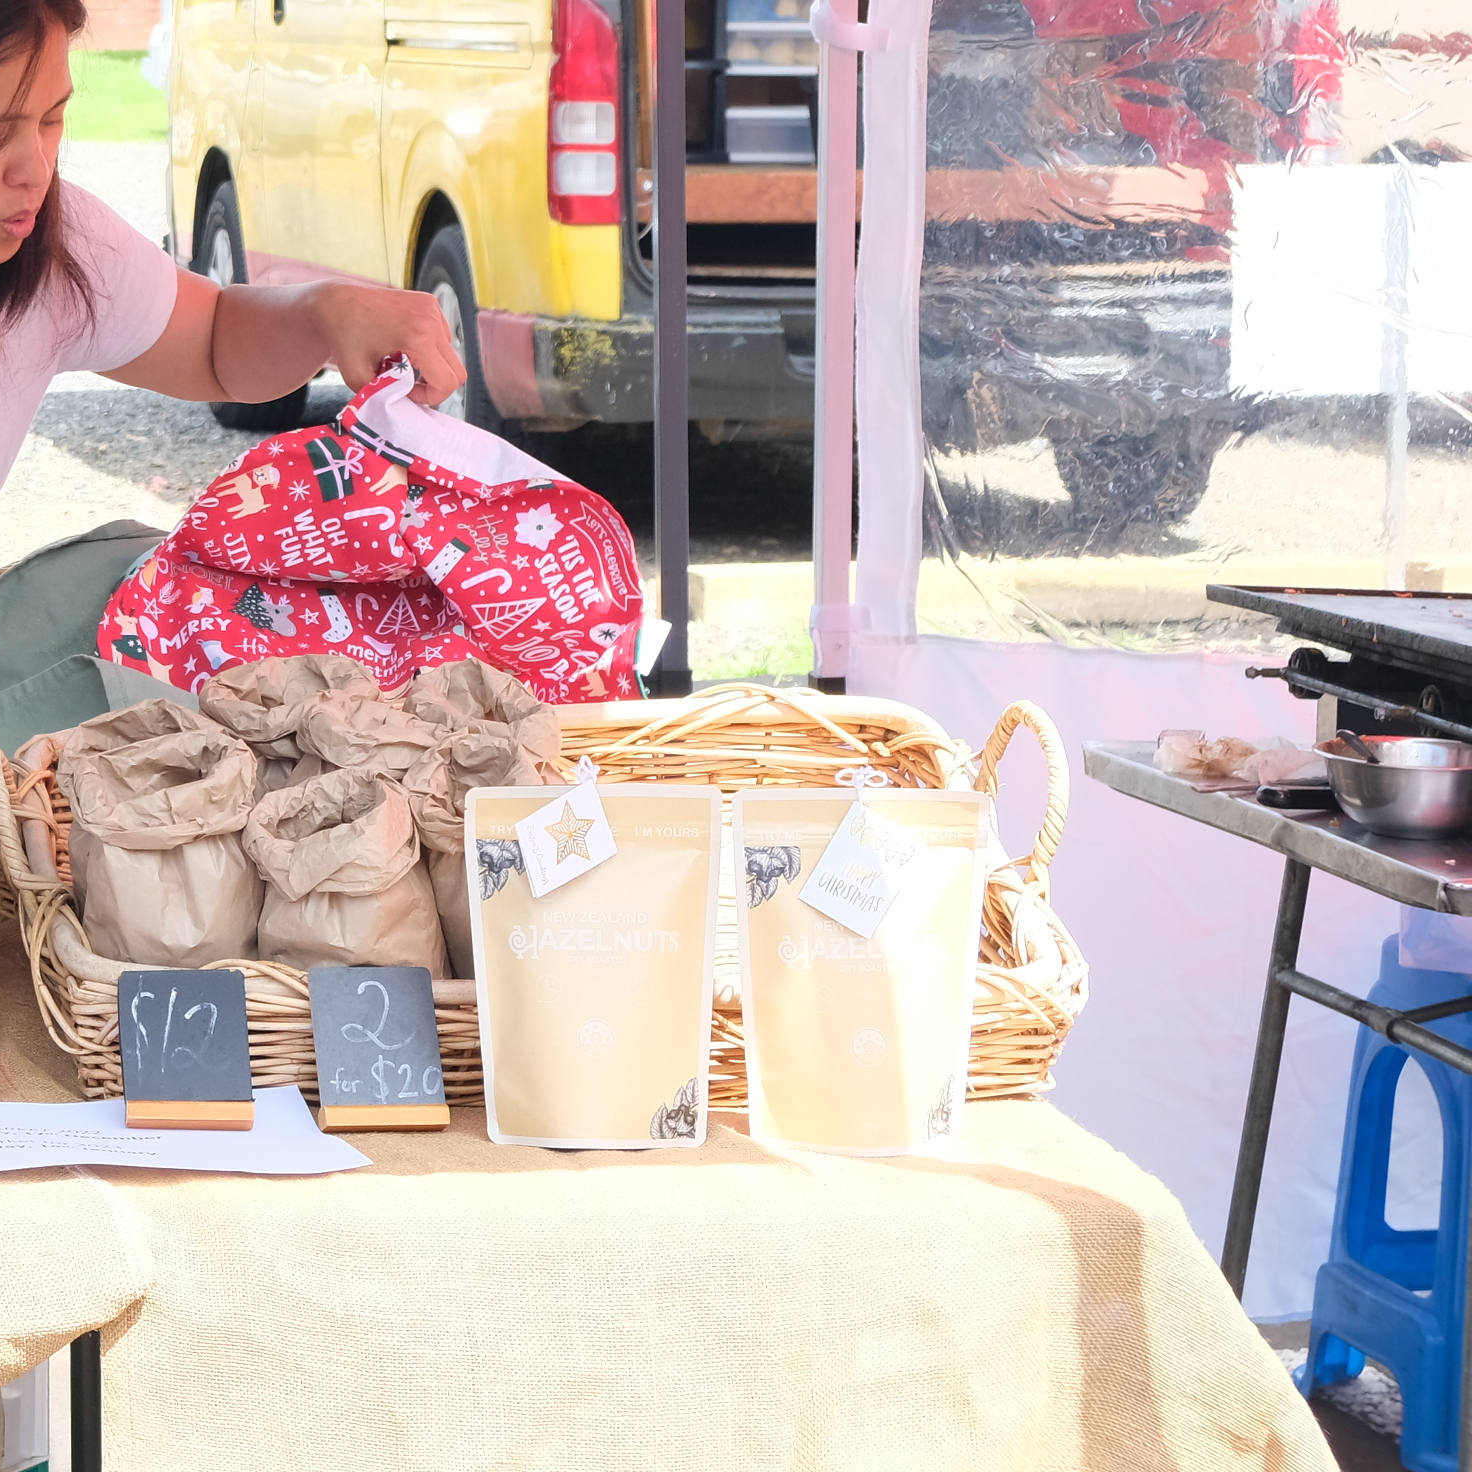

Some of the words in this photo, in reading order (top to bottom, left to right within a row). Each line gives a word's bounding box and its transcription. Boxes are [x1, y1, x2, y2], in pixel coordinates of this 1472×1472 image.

[273, 526, 305, 568] FUN
[293, 508, 335, 567] WHAT
[321, 517, 348, 548] OH
[170, 561, 238, 594] NOEL
[534, 552, 585, 625] SEASON
[571, 566, 605, 610] THE
[159, 617, 232, 654] MERRY
[346, 644, 398, 667] merry
[490, 825, 513, 835] TRY
[635, 827, 653, 837] I'M
[655, 827, 700, 838] YOURS
[841, 859, 882, 888] HAPPY
[818, 869, 885, 913] CHRISTMAS
[543, 912, 576, 923] NEW
[579, 912, 647, 924] ZEALAND
[508, 925, 680, 960] HAZELNUTS
[587, 956, 627, 964] ROASTED
[839, 964, 857, 972] DRY
[340, 980, 417, 1051] 2
[329, 1066, 362, 1095] for
[371, 1053, 443, 1102] $20
